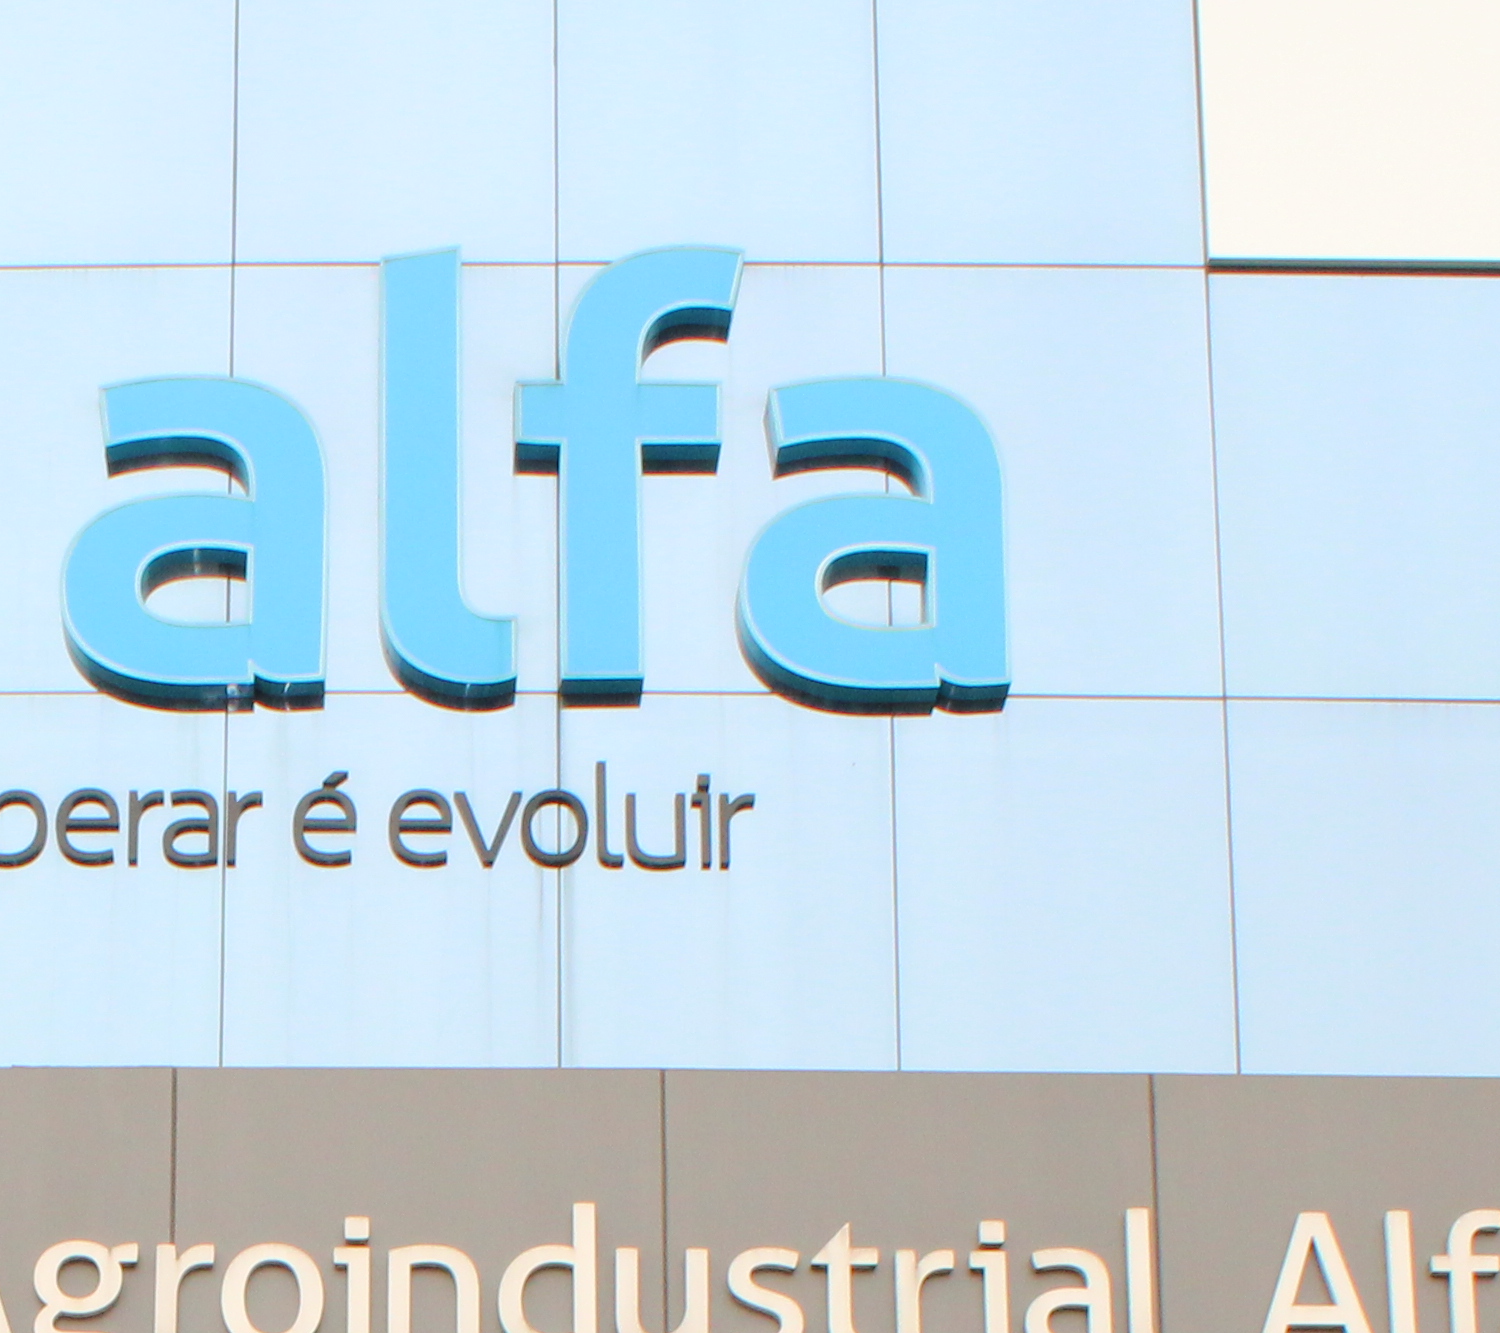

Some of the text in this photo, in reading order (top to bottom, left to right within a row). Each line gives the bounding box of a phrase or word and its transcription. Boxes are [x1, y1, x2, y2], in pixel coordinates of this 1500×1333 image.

[60, 244, 1013, 716] alfa
[293, 772, 358, 867] é
[388, 762, 755, 871] evoluir
